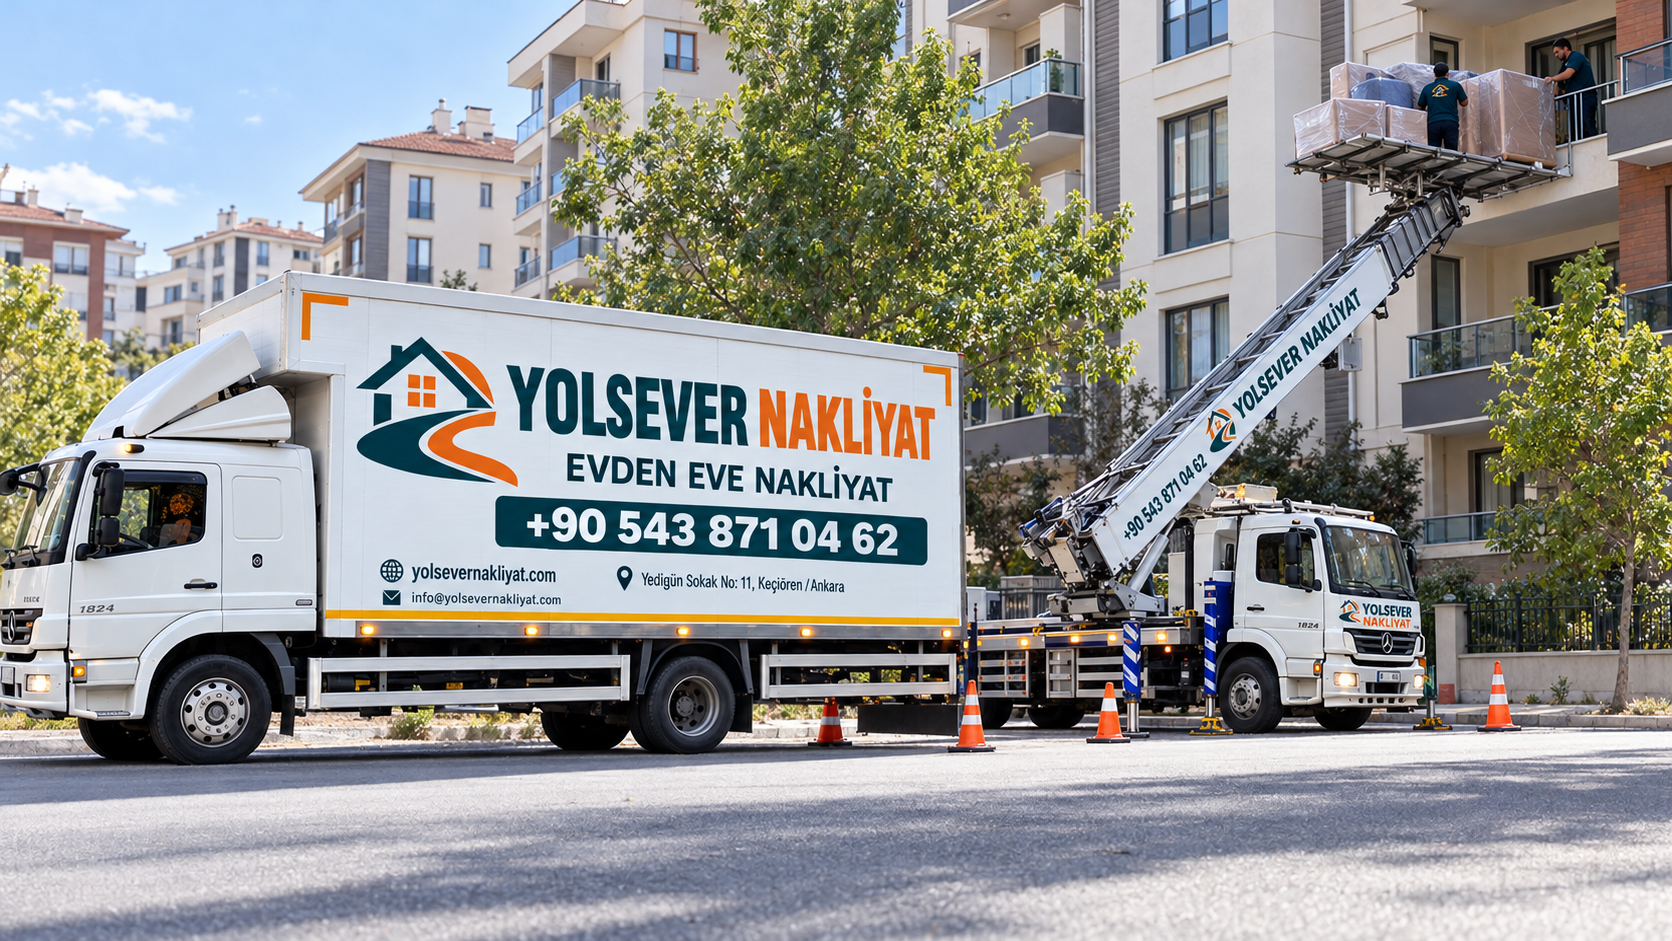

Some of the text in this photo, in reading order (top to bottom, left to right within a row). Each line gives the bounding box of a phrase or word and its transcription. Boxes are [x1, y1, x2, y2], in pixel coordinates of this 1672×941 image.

[1232, 287, 1361, 419] YOLSEVER NAKLİYAT
[506, 364, 935, 460] YOLSEVER NAKLİYAT
[567, 453, 893, 503] EVDEN EVE NAKLİYAT
[1124, 453, 1208, 540] +90 543 871 04 62
[527, 506, 898, 556] +90 543 871 04 62
[411, 563, 556, 585] yolsevernakliyat.com
[641, 572, 683, 590] Yedigün
[686, 573, 718, 588] Sokak
[721, 575, 738, 589] No:
[740, 576, 755, 592] 11,
[79, 604, 115, 613] 1824
[411, 591, 562, 607] info@yolsevernakliyat.com
[1362, 603, 1412, 618] YOLSEVER
